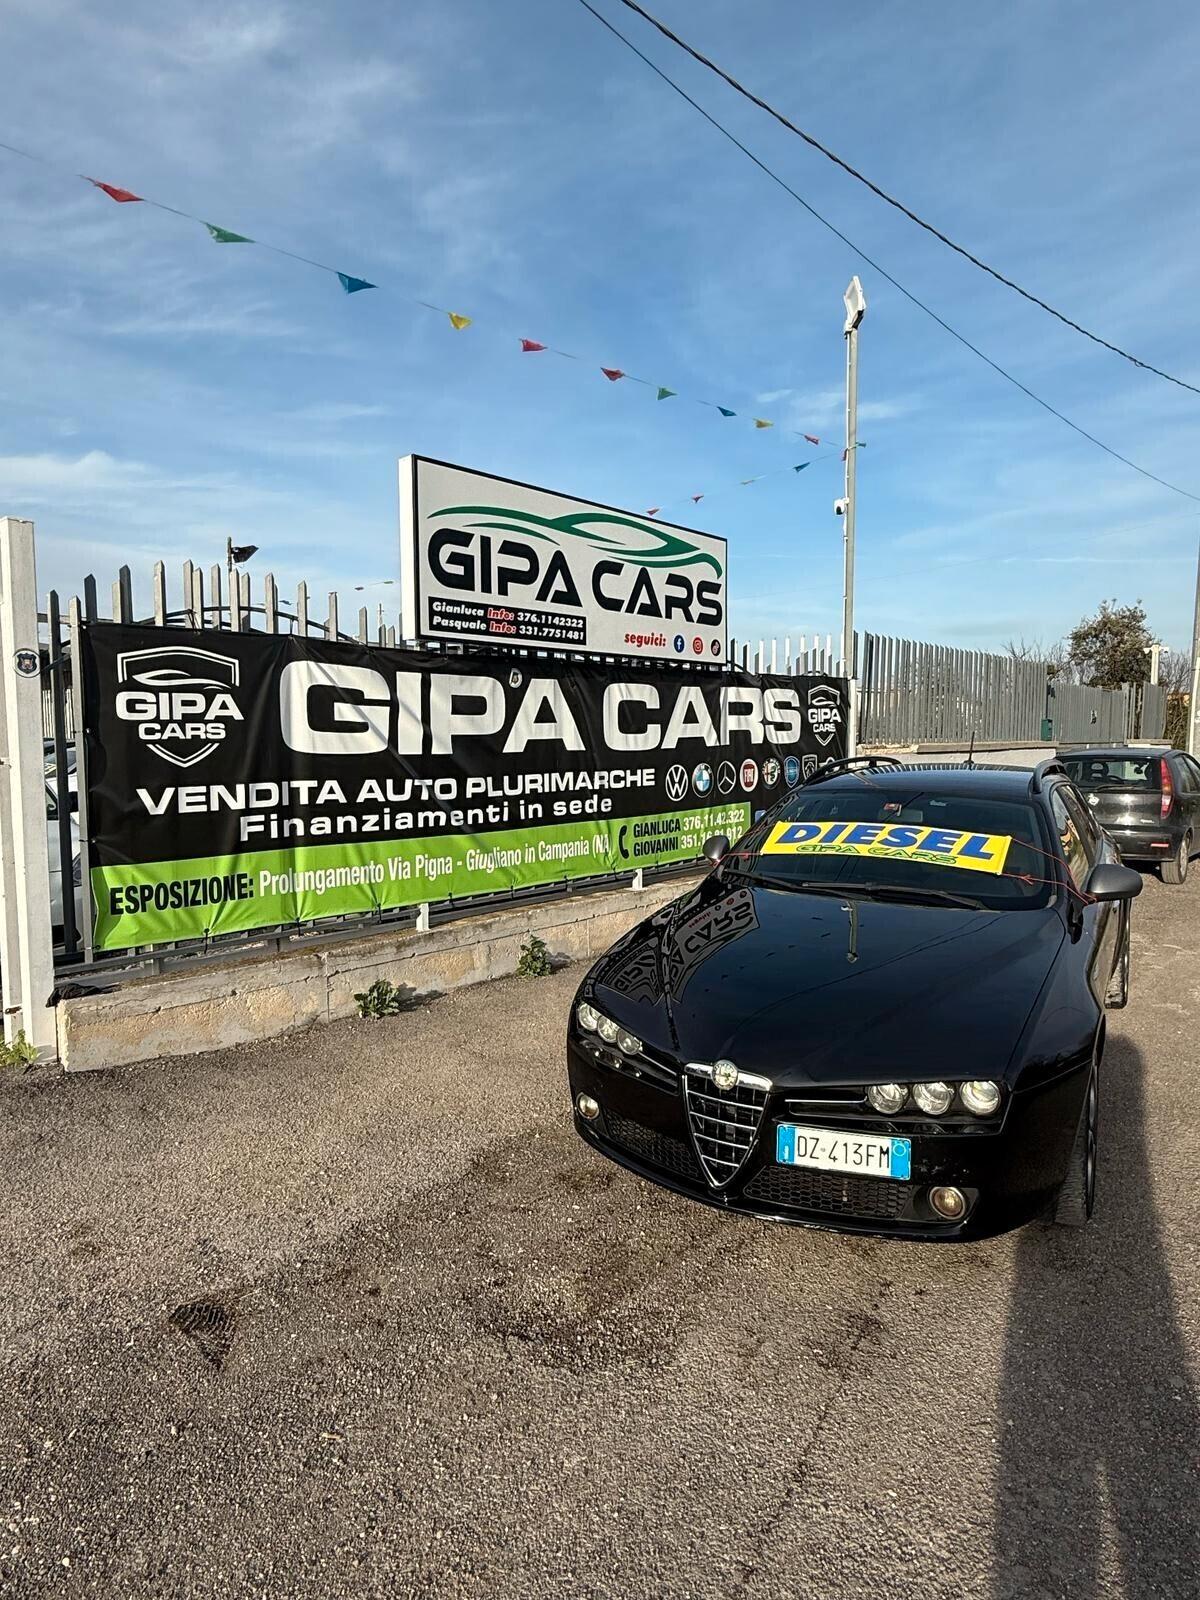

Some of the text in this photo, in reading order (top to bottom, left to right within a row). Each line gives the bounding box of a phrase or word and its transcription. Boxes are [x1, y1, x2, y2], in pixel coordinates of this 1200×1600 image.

[427, 528, 723, 627] GIPA CARS
[432, 601, 584, 628] Gianluca Info: 376.1142322
[432, 615, 585, 641] Pasquale Info: 331.7751481
[624, 632, 667, 648] seguici:
[115, 691, 245, 721] GIPA
[280, 660, 802, 755] GIPA CARS
[808, 708, 842, 723] GIPA
[138, 722, 226, 740] CARS
[812, 723, 836, 733] CARS
[135, 768, 656, 816] VENDITA AUTO PLURIMARCHE
[239, 794, 613, 842] Finanziamenti in sede
[633, 809, 745, 838] GIANLUCA 376.11.42.322
[633, 837, 679, 857] GIOVANNI
[774, 824, 1000, 861] DIESEL
[795, 844, 959, 865] GIPA CARS
[109, 872, 255, 916] ESPOSIZIONE:
[259, 860, 385, 897] Prolungamento
[387, 857, 411, 882] Via
[415, 854, 453, 881] Pigna
[466, 848, 522, 874] Giugliano
[525, 843, 536, 863] in
[538, 836, 589, 862] Campania
